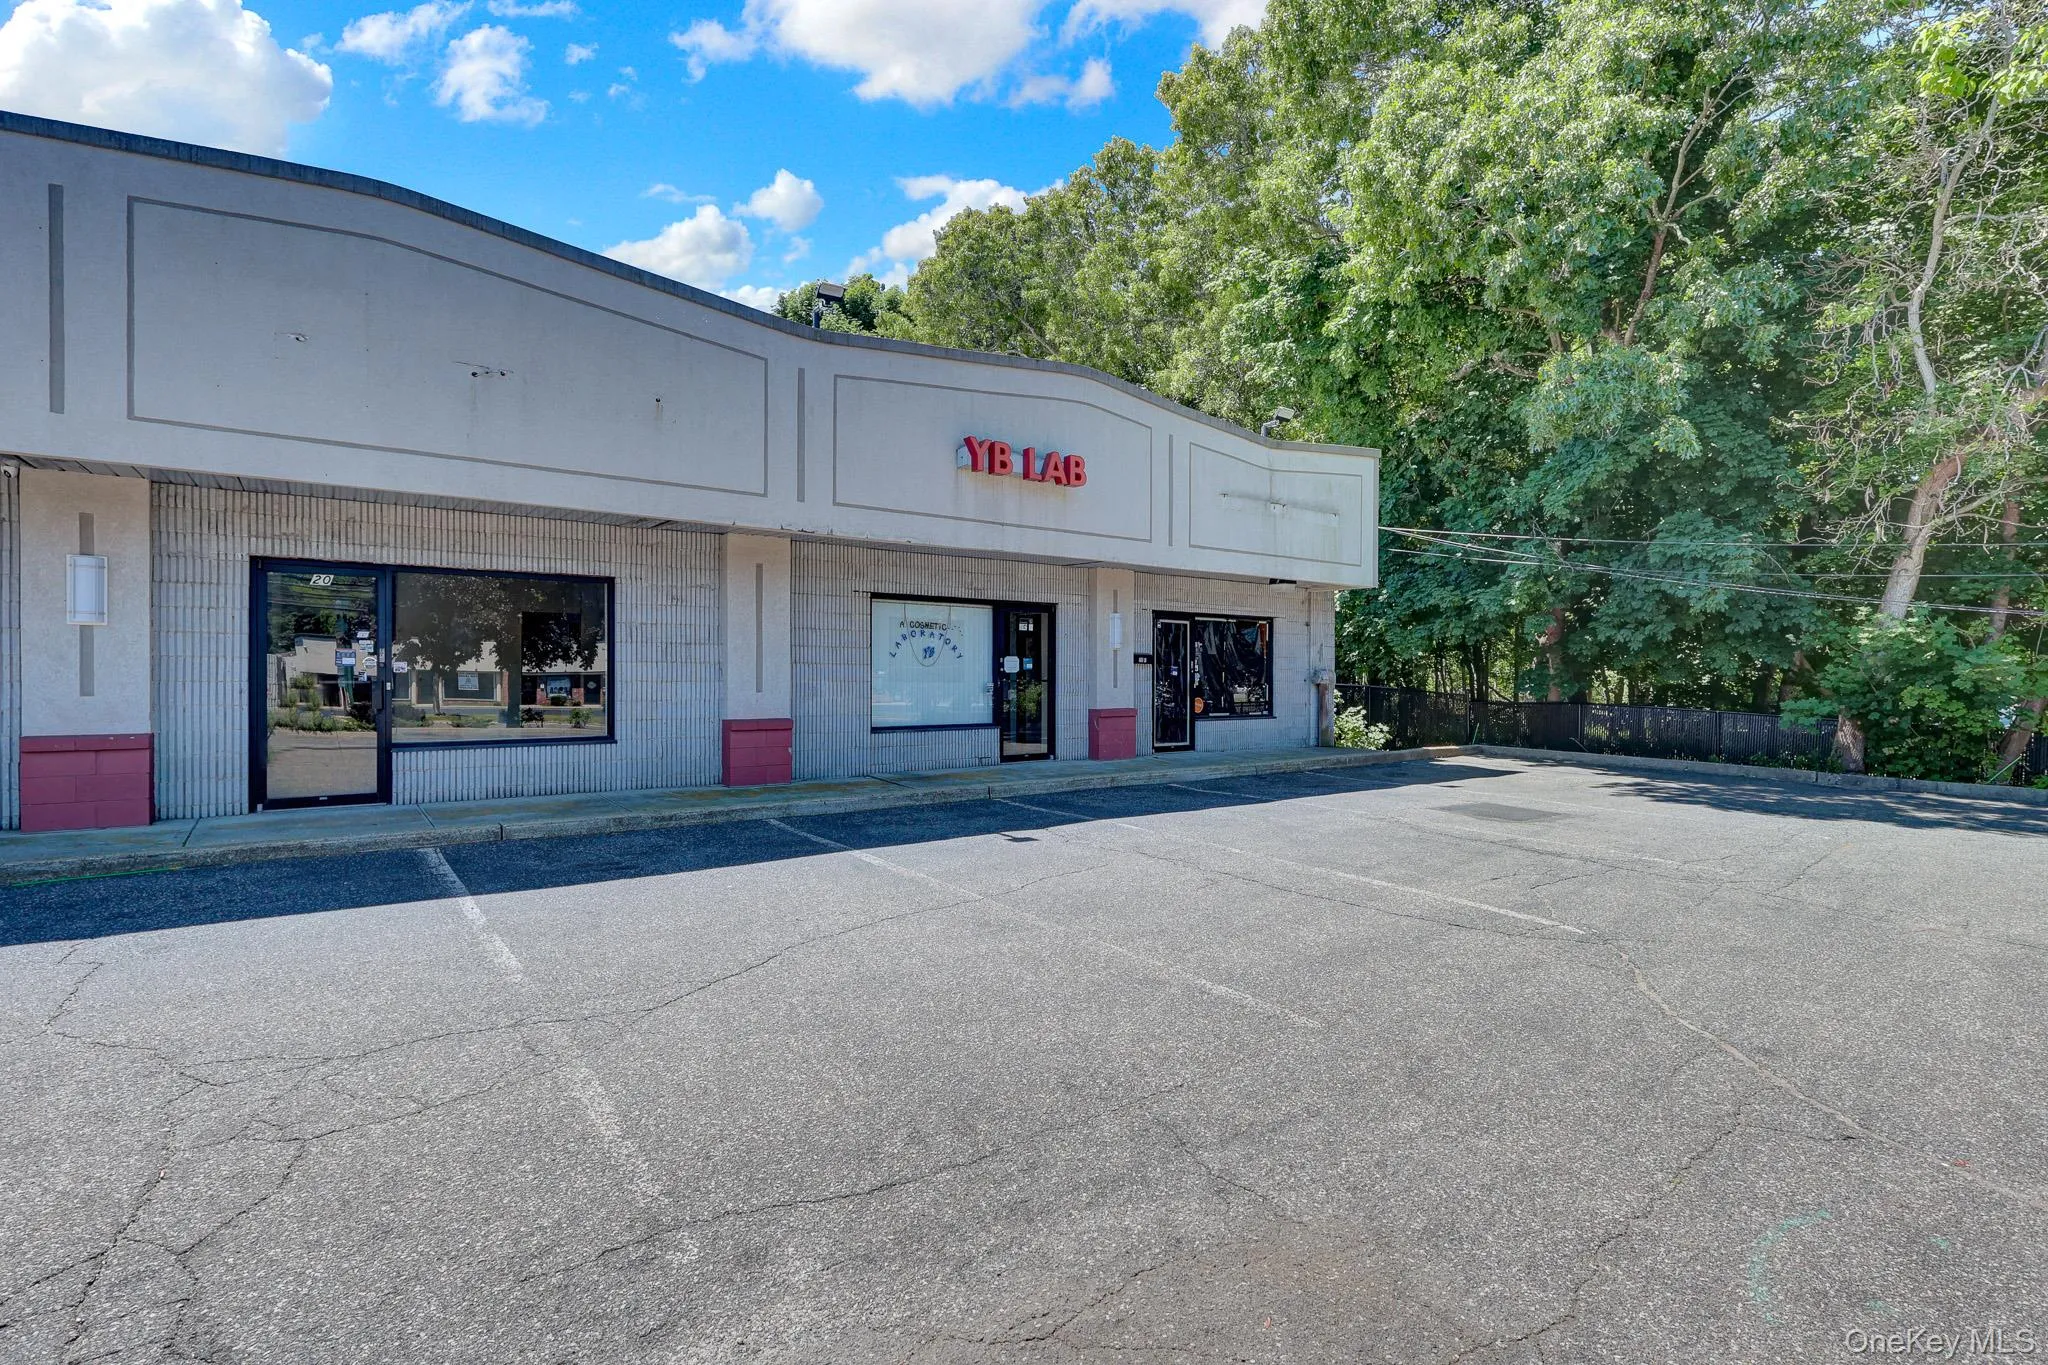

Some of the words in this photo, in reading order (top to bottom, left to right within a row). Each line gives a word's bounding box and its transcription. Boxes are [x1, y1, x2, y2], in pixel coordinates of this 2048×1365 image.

[963, 435, 1013, 476] YB
[1022, 447, 1087, 487] LAB
[312, 575, 332, 585] 20
[899, 620, 905, 628] A
[909, 621, 948, 631] COSMETIC
[889, 629, 964, 659] LABORATORY
